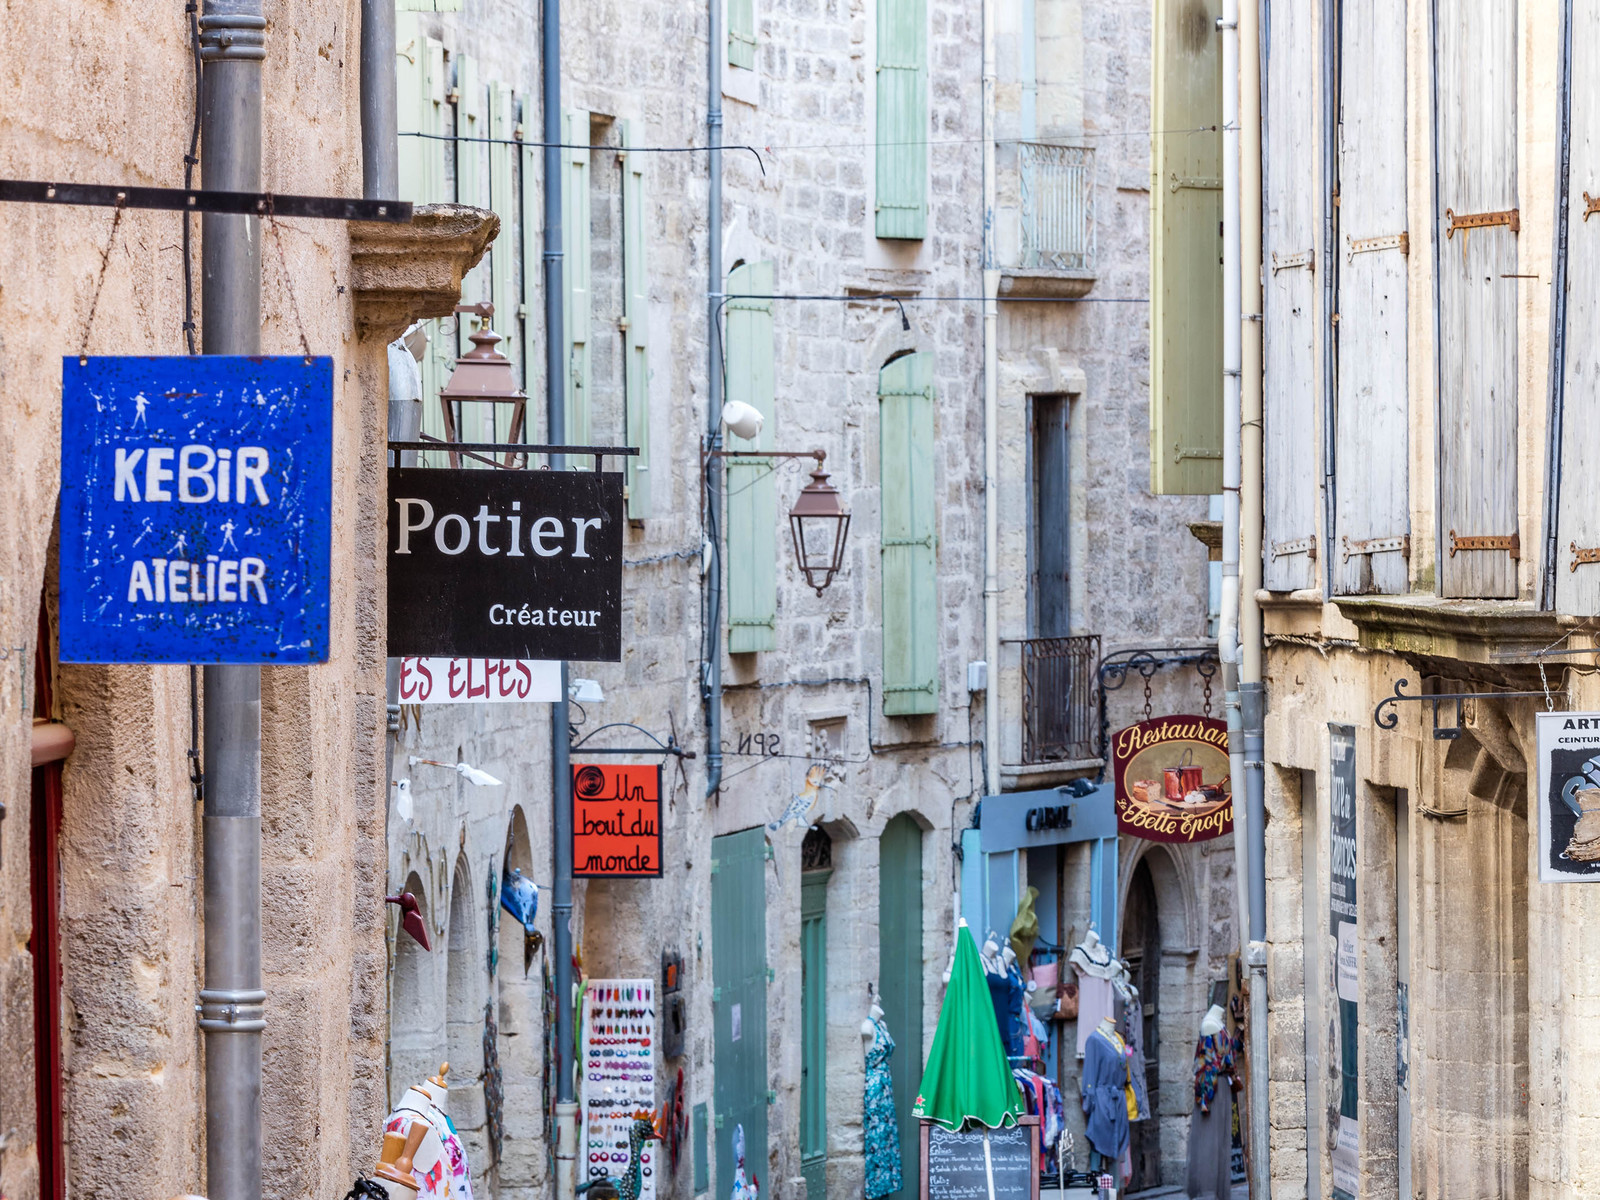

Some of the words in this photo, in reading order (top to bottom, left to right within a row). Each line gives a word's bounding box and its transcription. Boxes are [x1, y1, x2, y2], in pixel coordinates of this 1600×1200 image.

[394, 498, 601, 558] Potier
[489, 603, 601, 627] Créateur
[400, 657, 432, 700] ES
[1117, 721, 1229, 759] Restauran
[615, 773, 645, 802] Un
[583, 808, 624, 836] bout
[631, 808, 654, 837] du
[1180, 806, 1234, 842] Epoqu
[586, 845, 650, 871] monde
